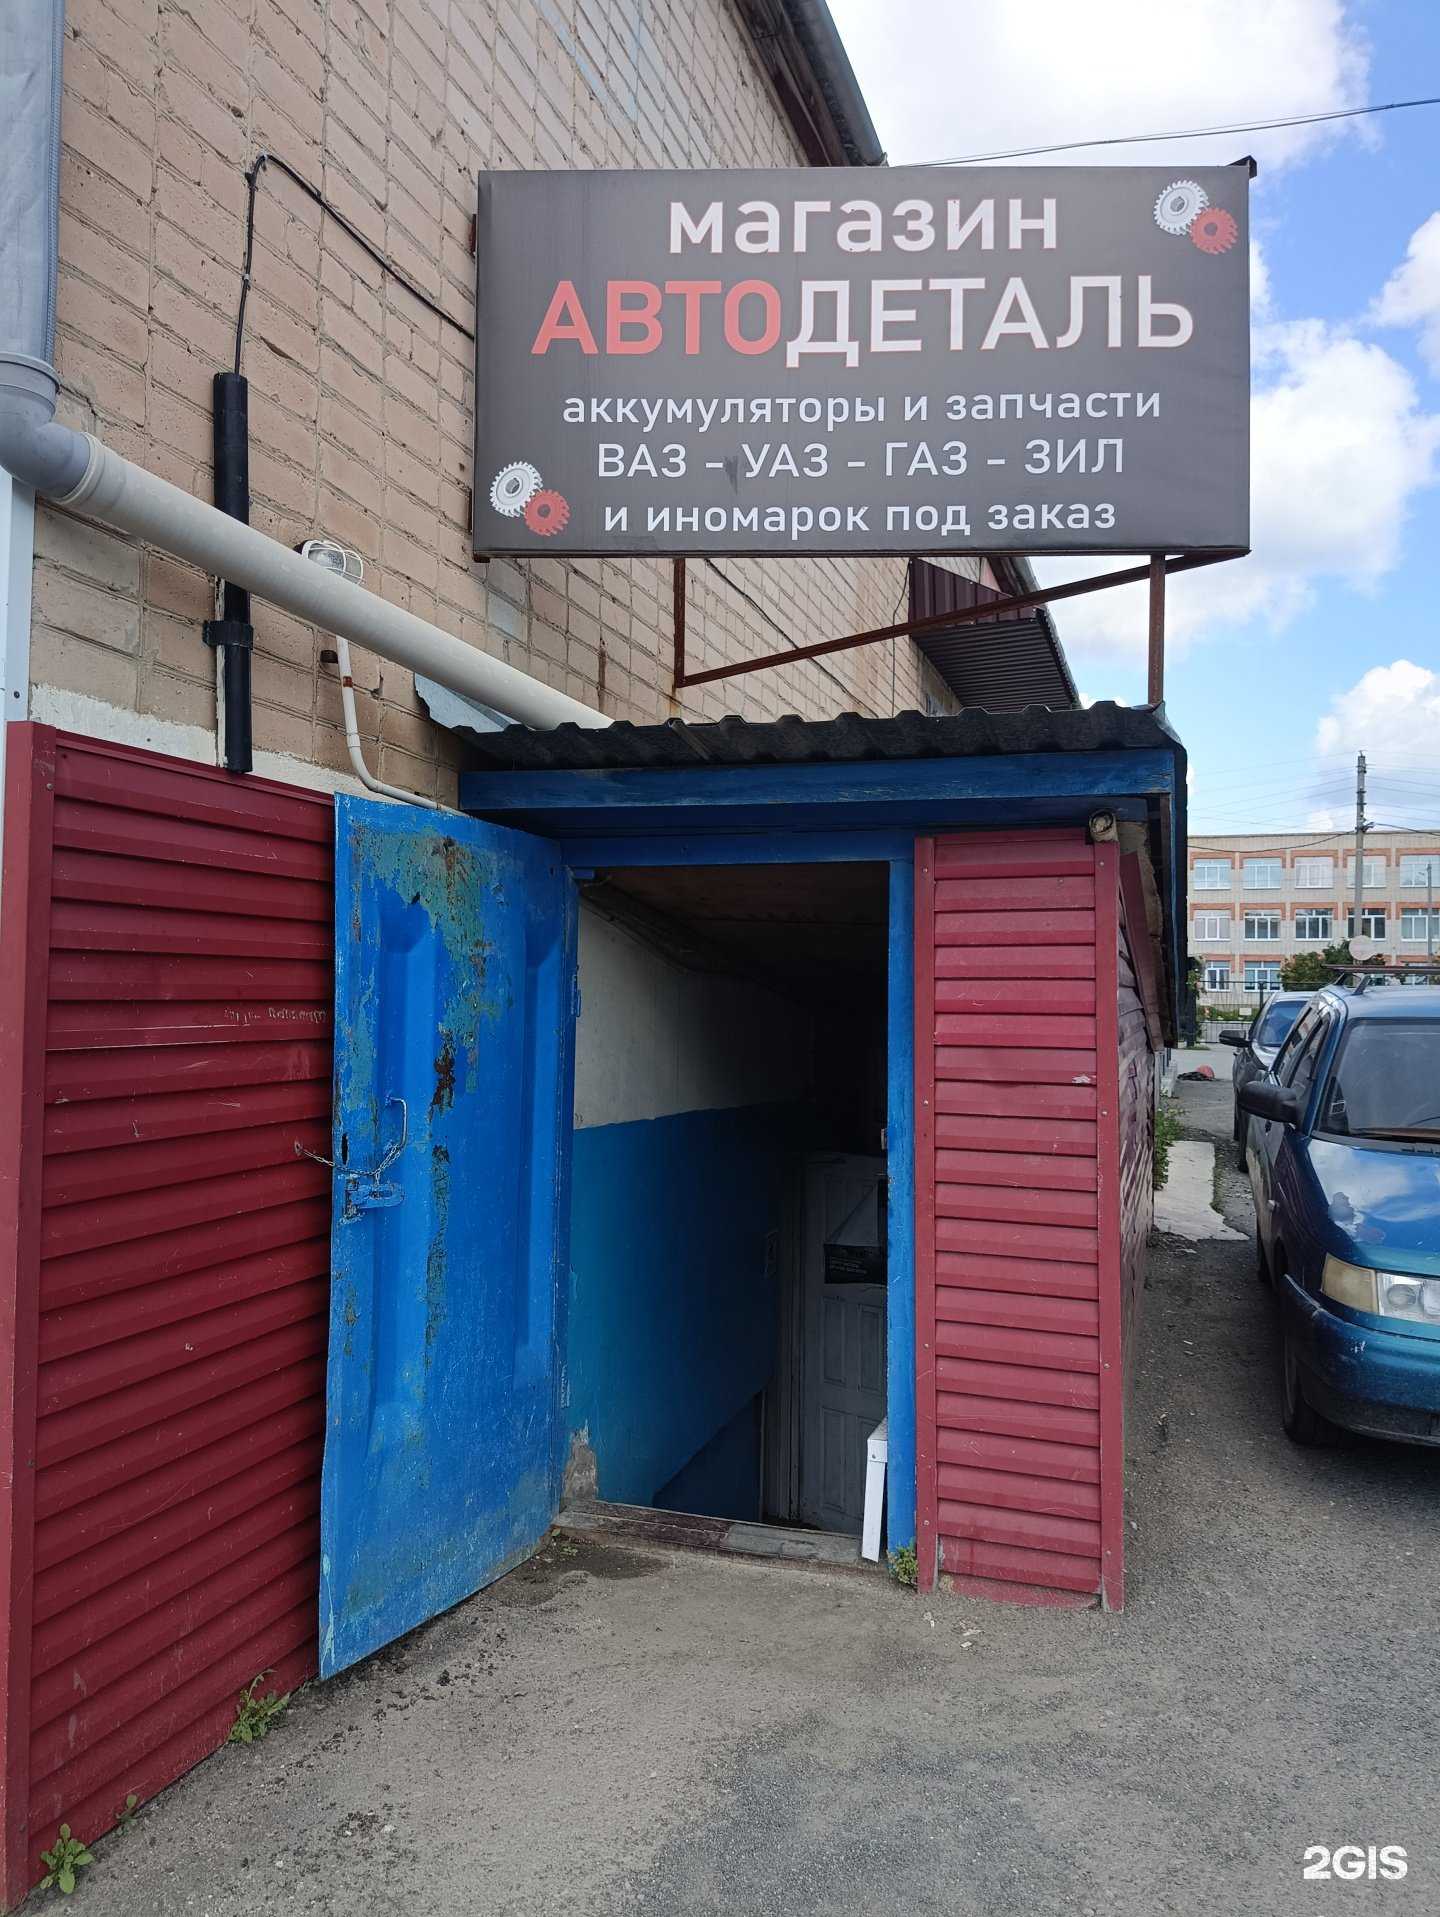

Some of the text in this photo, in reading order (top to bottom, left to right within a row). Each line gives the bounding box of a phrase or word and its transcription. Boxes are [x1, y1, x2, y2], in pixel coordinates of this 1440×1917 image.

[669, 198, 1057, 254] магазин
[531, 274, 1194, 368] АВТОДЕТАЛЬ
[563, 392, 1160, 433] аккумуляторы и запчасти
[598, 443, 687, 478] ВАЗ
[741, 442, 828, 478] УАЗ
[885, 440, 968, 477] ГАЗ
[1024, 438, 1123, 474] ЗИЛ
[604, 502, 1116, 541] и иномарок под заказ
